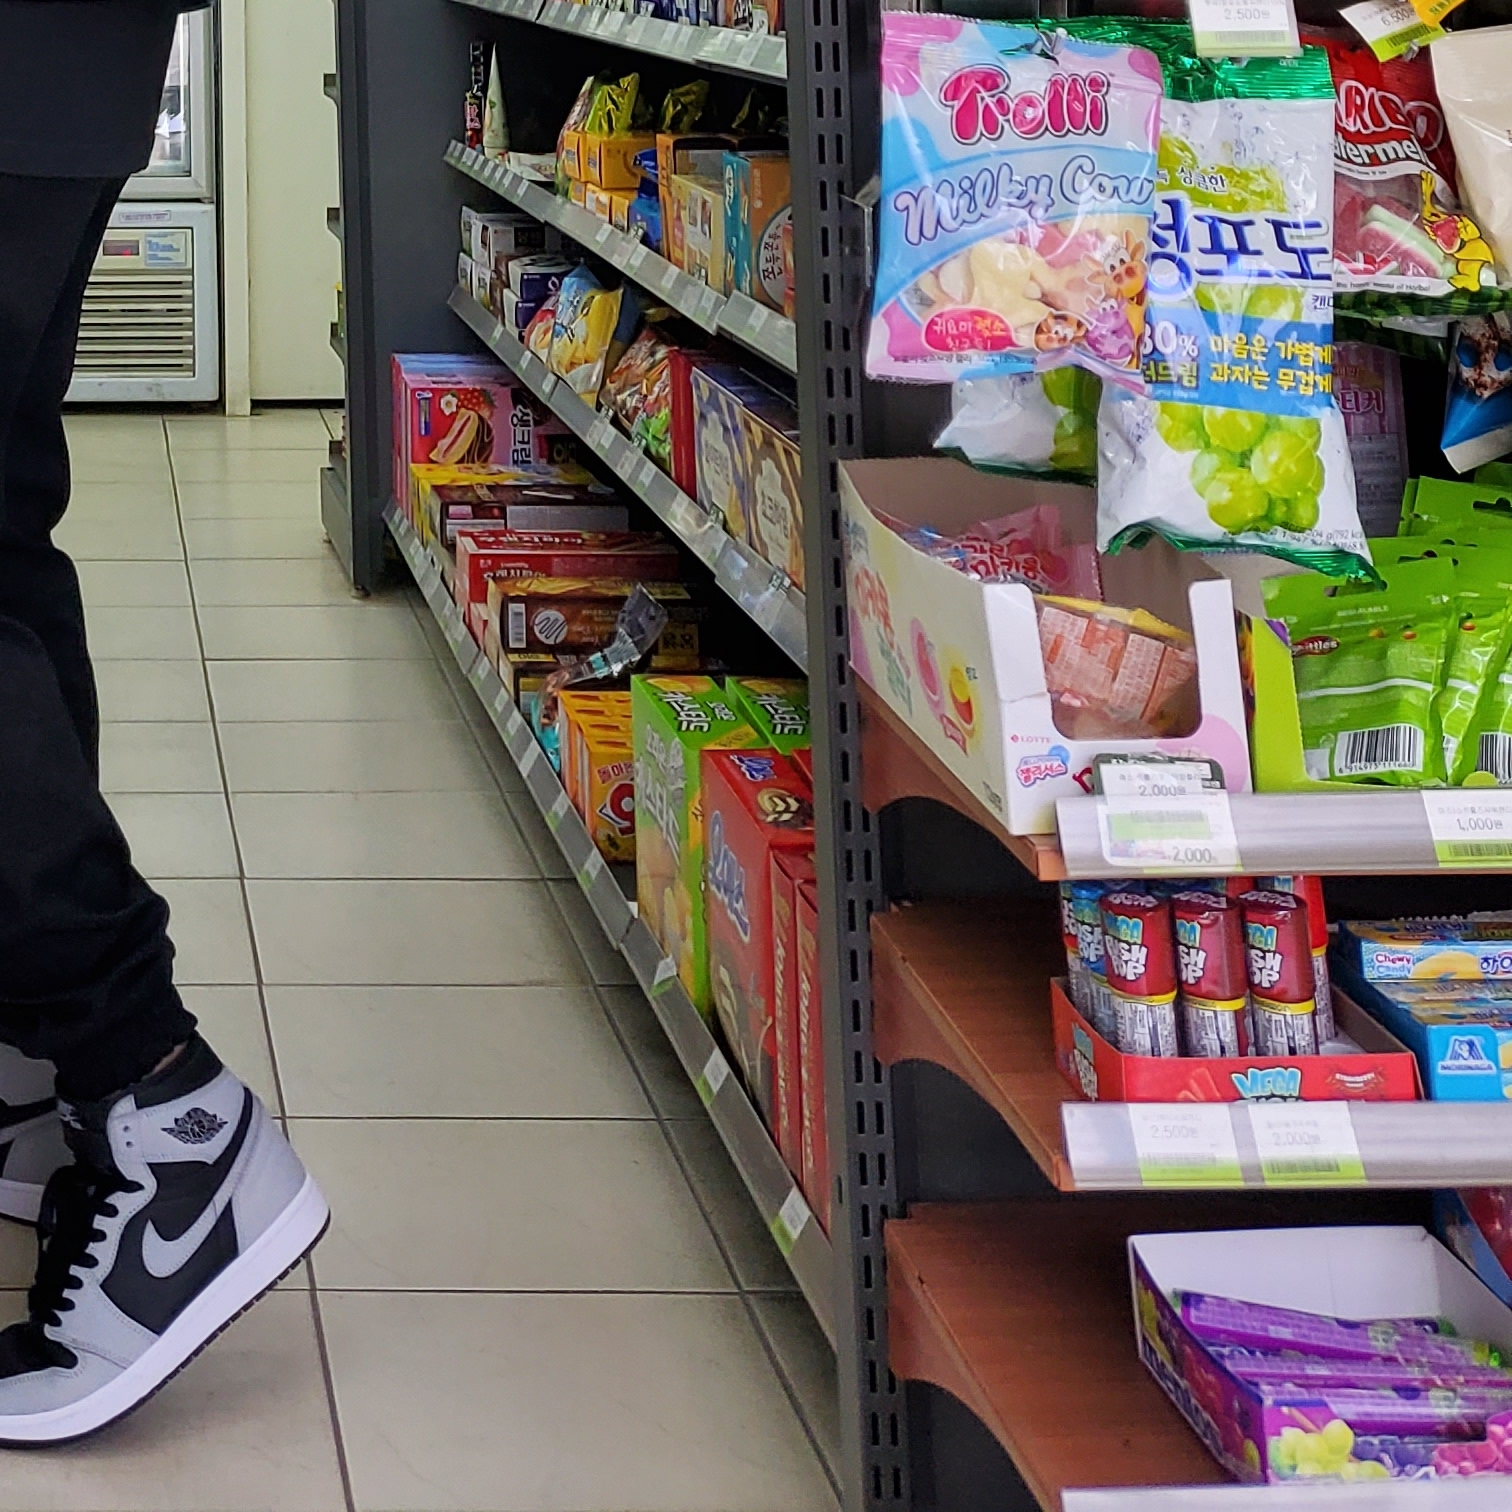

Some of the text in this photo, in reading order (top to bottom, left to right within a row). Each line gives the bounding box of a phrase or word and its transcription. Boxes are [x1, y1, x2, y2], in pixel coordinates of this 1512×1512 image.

[940, 64, 1111, 145] Trolli
[894, 154, 1155, 245] Milky Cow
[1209, 333, 1269, 361] 마음은
[1209, 362, 1270, 386] 과자는
[1375, 953, 1411, 965] Chewy
